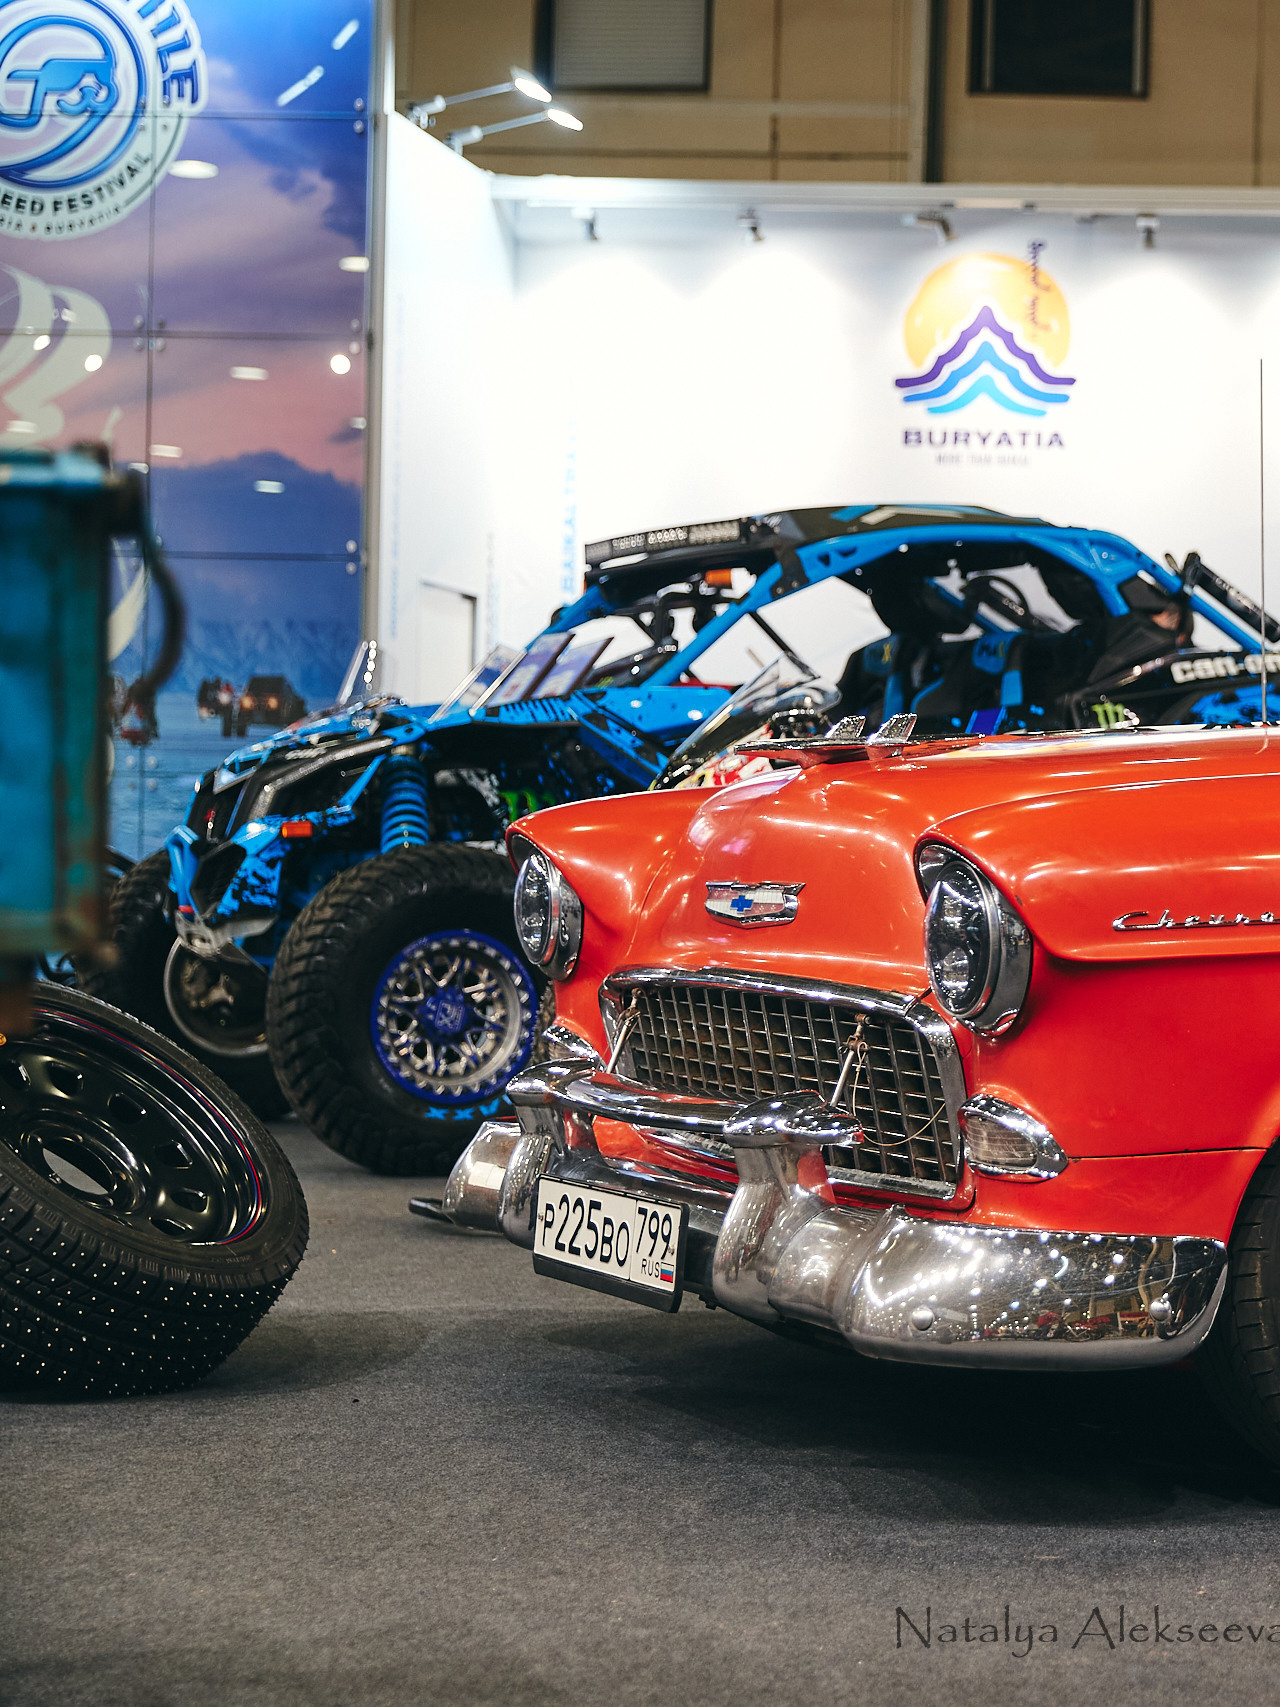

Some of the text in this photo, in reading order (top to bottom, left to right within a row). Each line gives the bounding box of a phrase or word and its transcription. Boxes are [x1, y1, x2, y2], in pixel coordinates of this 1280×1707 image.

[0, 153, 151, 216] EED FESTIVAL
[902, 429, 1065, 448] BURYATIA
[636, 1207, 673, 1260] 799
[641, 1258, 661, 1279] RUS
